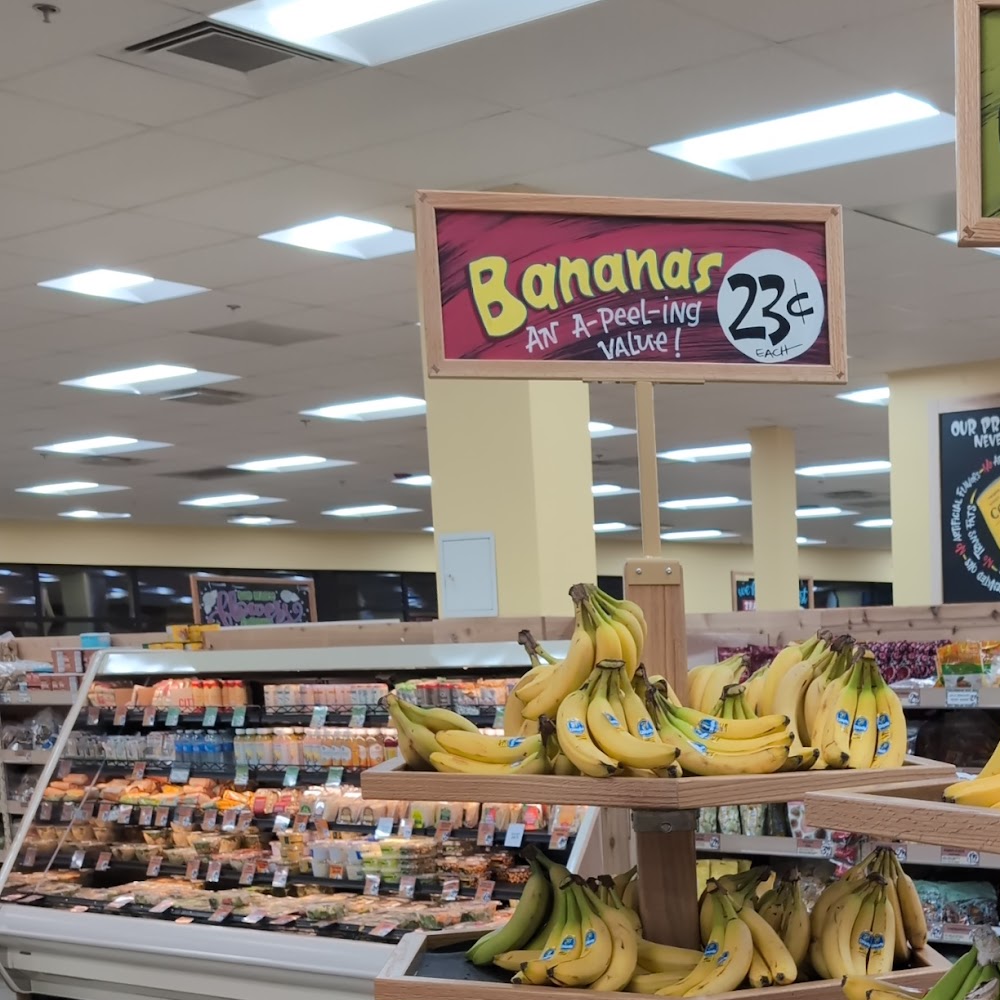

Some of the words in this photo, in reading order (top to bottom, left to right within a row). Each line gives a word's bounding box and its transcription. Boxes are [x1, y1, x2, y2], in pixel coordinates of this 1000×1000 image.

[469, 248, 722, 337] Bananas
[727, 273, 814, 346] 23¢
[756, 344, 803, 358] EACH
[951, 418, 976, 436] OUR
[951, 497, 963, 541] ARTIFICIAL
[966, 505, 976, 528] FATS
